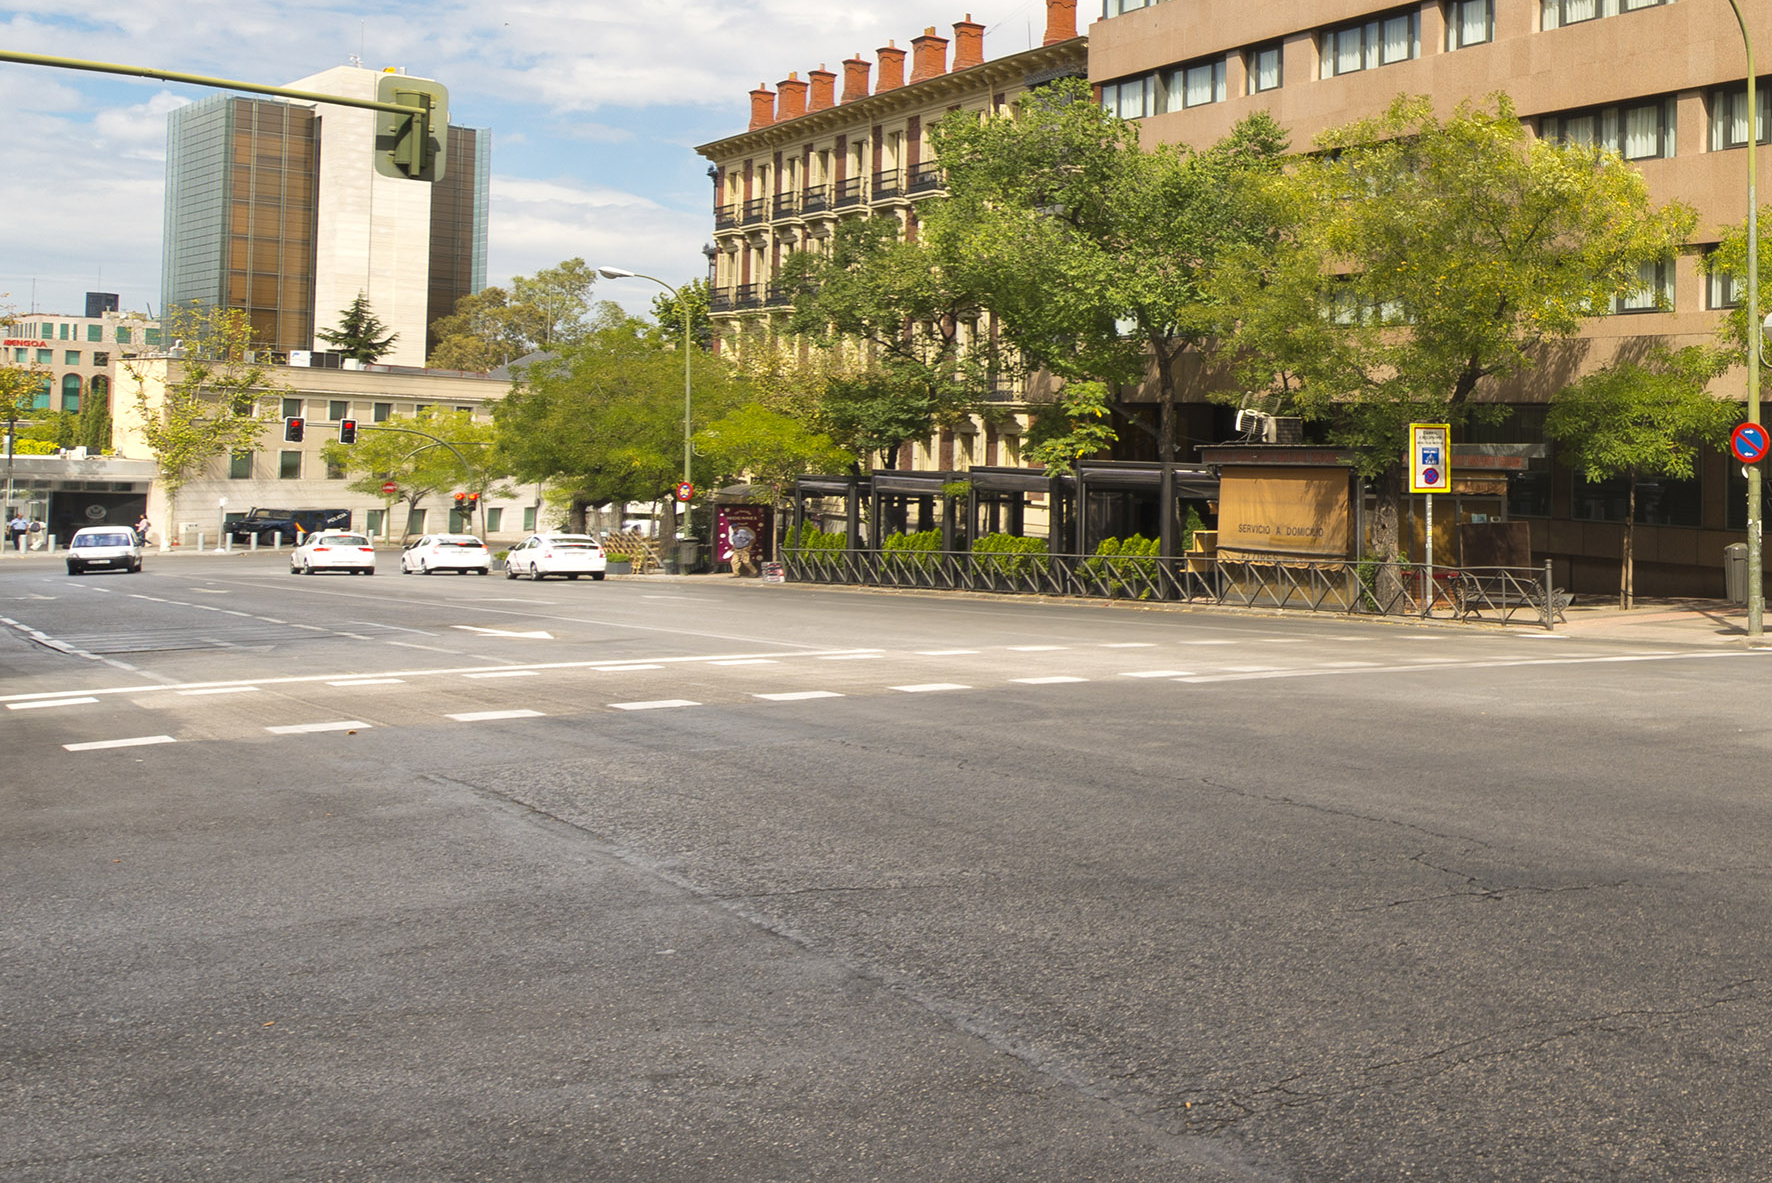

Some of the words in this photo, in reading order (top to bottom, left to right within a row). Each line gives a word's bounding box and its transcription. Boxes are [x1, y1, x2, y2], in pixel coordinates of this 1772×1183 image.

[1238, 523, 1271, 535] SERVICIO
[1275, 527, 1282, 536] A
[1286, 526, 1324, 537] DOMICILIO
